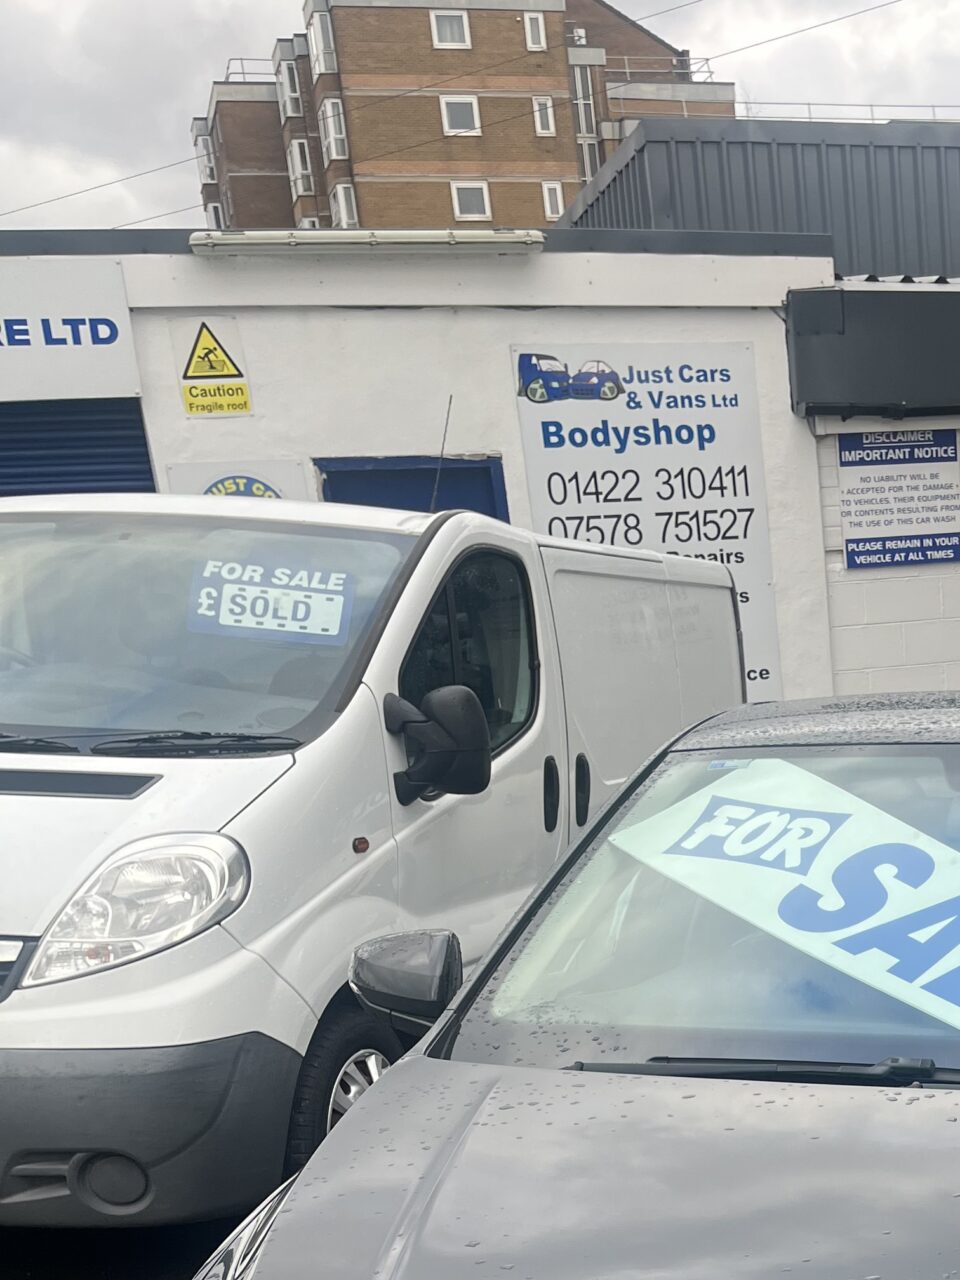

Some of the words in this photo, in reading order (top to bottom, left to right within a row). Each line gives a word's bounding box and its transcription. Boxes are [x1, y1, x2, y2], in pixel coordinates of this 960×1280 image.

[41, 318, 119, 346] LTD
[622, 364, 674, 384] Just
[678, 364, 731, 383] Cars
[188, 385, 244, 398] Caution
[189, 402, 225, 413] Fragile
[227, 401, 248, 411] roof
[626, 391, 643, 410] &
[647, 390, 706, 409] Vans
[711, 393, 739, 408] Ltd
[541, 418, 716, 454] Bodyshop
[863, 430, 933, 444] DISCLAIMER
[841, 448, 911, 462] IMPORTANT
[914, 446, 956, 459] NOTICE
[547, 469, 643, 505] 01422
[654, 464, 749, 501] 310411
[860, 476, 872, 484] NO
[930, 472, 940, 480] BE
[846, 487, 886, 495] ACCEPTED
[888, 485, 904, 493] FOR
[906, 484, 921, 492] THE
[841, 499, 852, 507] TO
[893, 495, 916, 504] THEIR
[917, 493, 960, 502] EQUIPMENT
[841, 510, 852, 518] OR
[855, 508, 895, 517] CONTENTS
[897, 505, 939, 514] RESULTING
[548, 513, 643, 545] 07578
[655, 507, 755, 544] 751527
[866, 519, 881, 527] USE
[884, 519, 894, 527] OF
[897, 517, 914, 525] THIS
[916, 516, 931, 524] CAR
[933, 515, 956, 523] WASH
[848, 540, 883, 552] PLEASE
[885, 538, 921, 549] REMAIN
[923, 537, 933, 547] IN
[934, 536, 959, 547] YOUR
[854, 553, 892, 565] VEHICLE
[894, 552, 905, 562] AT
[908, 551, 924, 561] ALL
[926, 549, 954, 559] TIMES
[203, 560, 264, 583] FOR
[271, 567, 347, 591] SALE
[197, 587, 218, 616] £
[228, 593, 312, 622] SOLD
[680, 804, 831, 869] FOR
